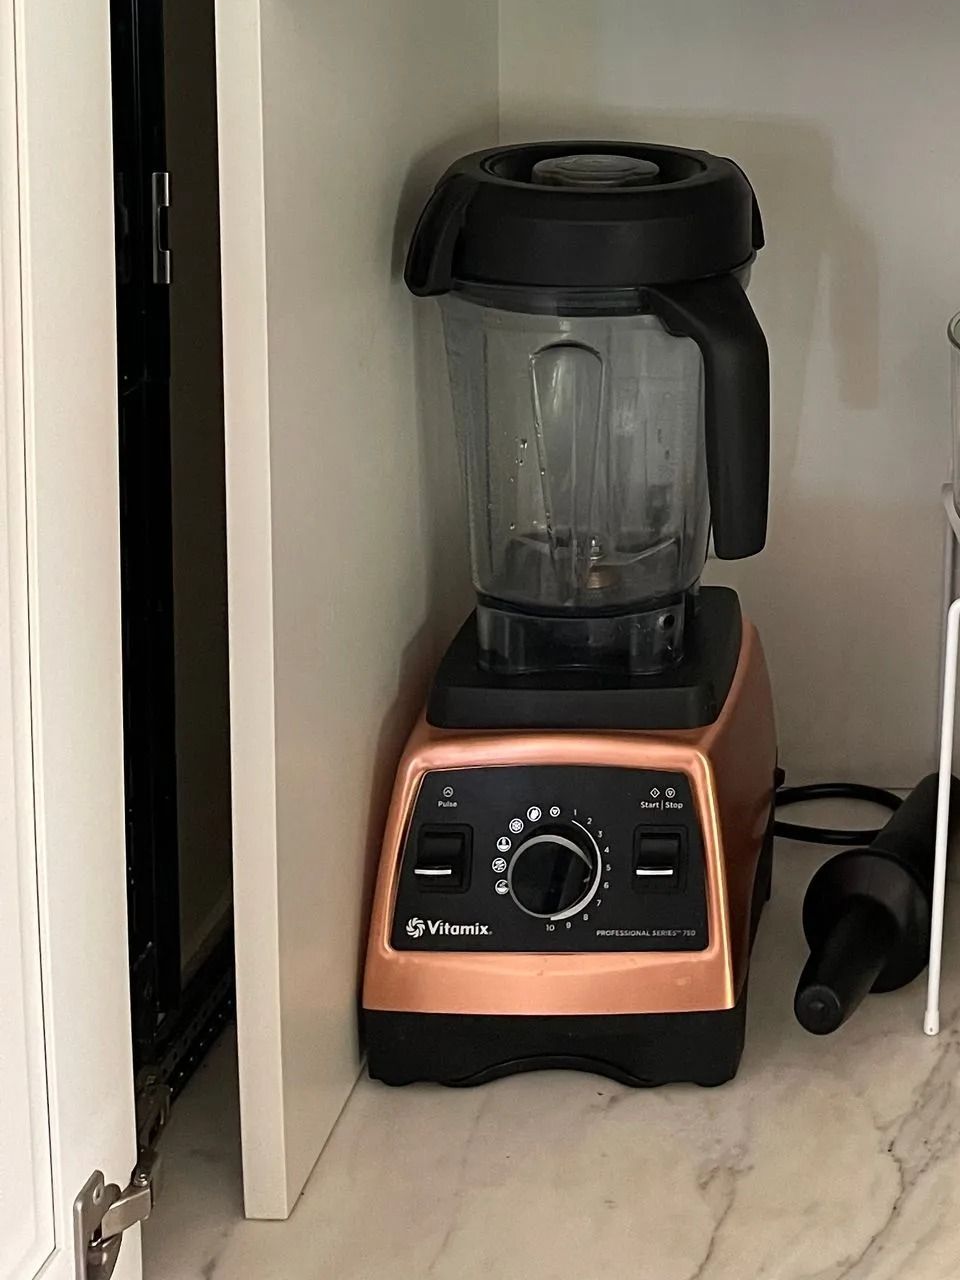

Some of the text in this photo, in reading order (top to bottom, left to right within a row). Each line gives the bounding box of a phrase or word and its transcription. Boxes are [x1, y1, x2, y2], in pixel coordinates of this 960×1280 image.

[438, 800, 457, 808] Pulse
[640, 801, 684, 810] Start Stop
[427, 919, 489, 936] Vitamix
